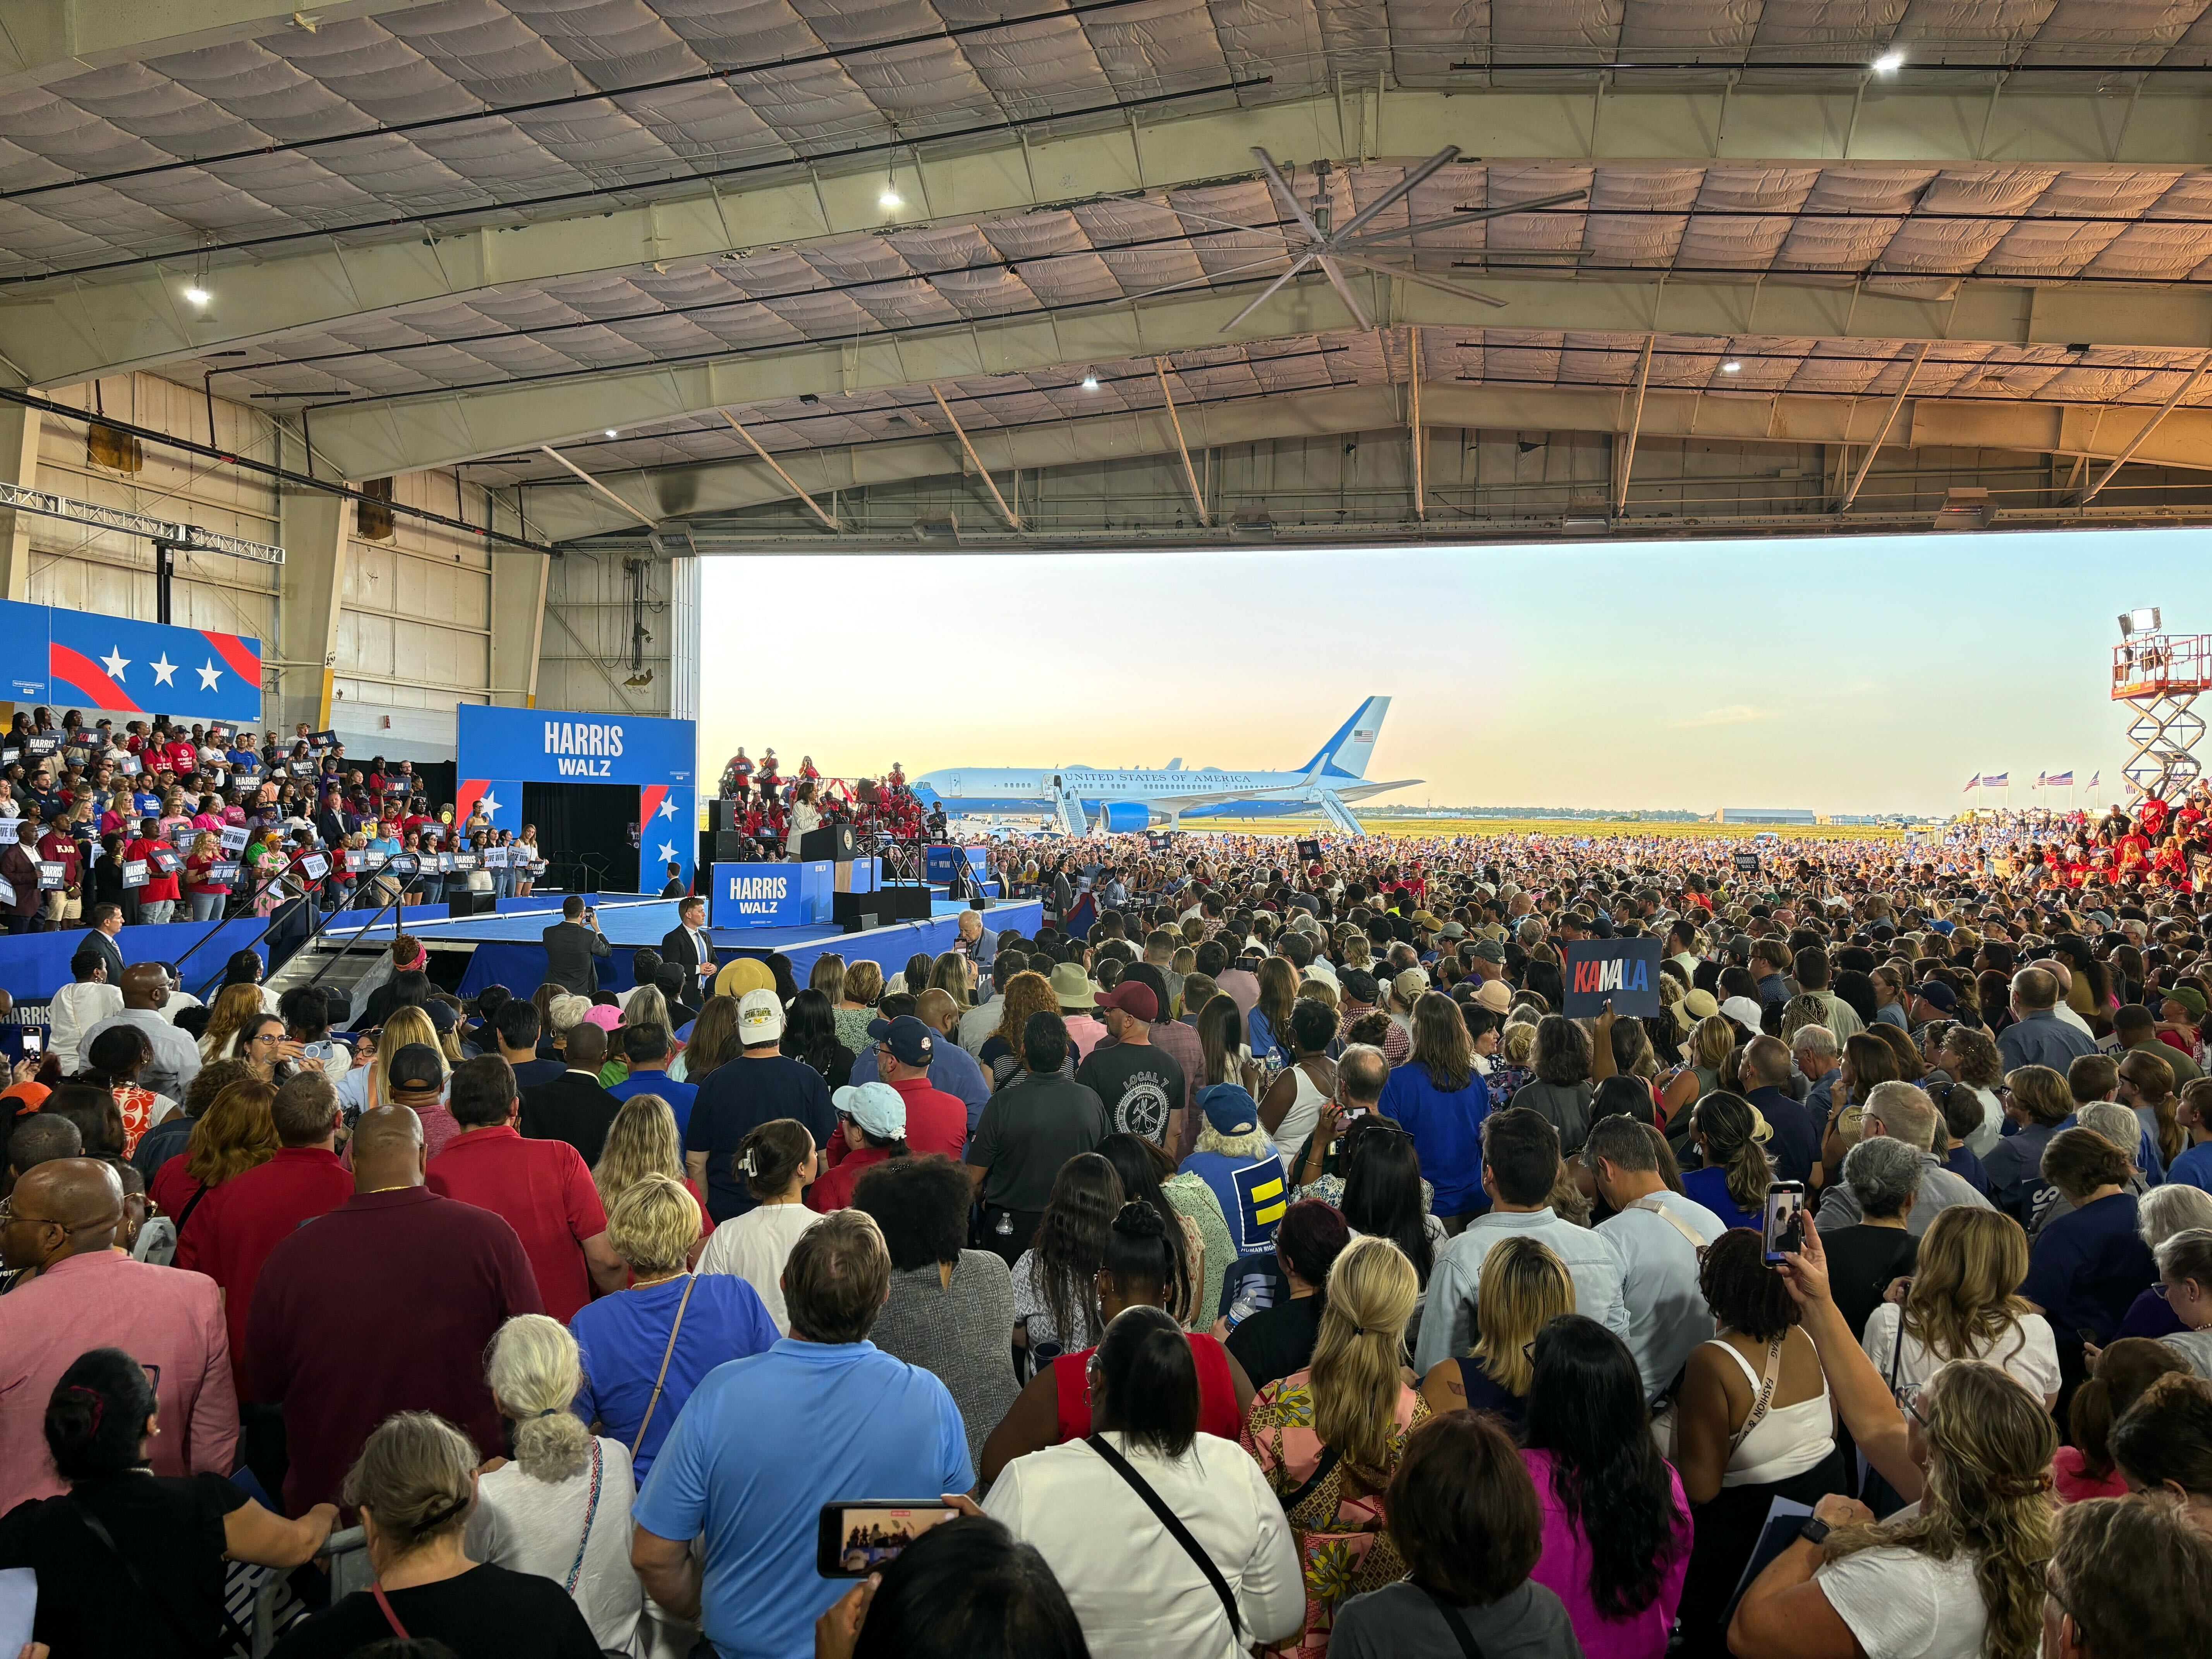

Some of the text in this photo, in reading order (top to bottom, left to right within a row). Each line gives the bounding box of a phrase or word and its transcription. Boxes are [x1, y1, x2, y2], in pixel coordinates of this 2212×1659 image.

[29, 738, 55, 748] HARRIS
[310, 733, 335, 745] KAMALA
[544, 721, 623, 757] HARRIS
[292, 762, 313, 770] HARRIS
[558, 758, 611, 776] WALZ
[235, 776, 260, 786] HARRIS
[387, 783, 409, 791] KAMALA
[232, 835, 245, 845] WIN
[1299, 845, 1317, 855] KAMALA
[368, 852, 385, 861] HARRIS
[454, 855, 476, 864] HARRIS
[1736, 856, 1756, 864] HARRIS
[2193, 853, 2211, 864] HARRIS
[308, 862, 326, 873] WE WIN
[400, 860, 412, 869] WIN
[40, 866, 63, 878] HARRIS
[126, 864, 146, 877] HARRIS
[222, 869, 235, 878] WIN
[730, 877, 787, 900] HARRIS
[740, 902, 777, 914] WALZ
[1573, 958, 1649, 993] KAMALA
[1123, 1071, 1169, 1090] LOCAL 7
[1122, 1093, 1134, 1107] SHEET
[1748, 1377, 1773, 1428] FASHION &
